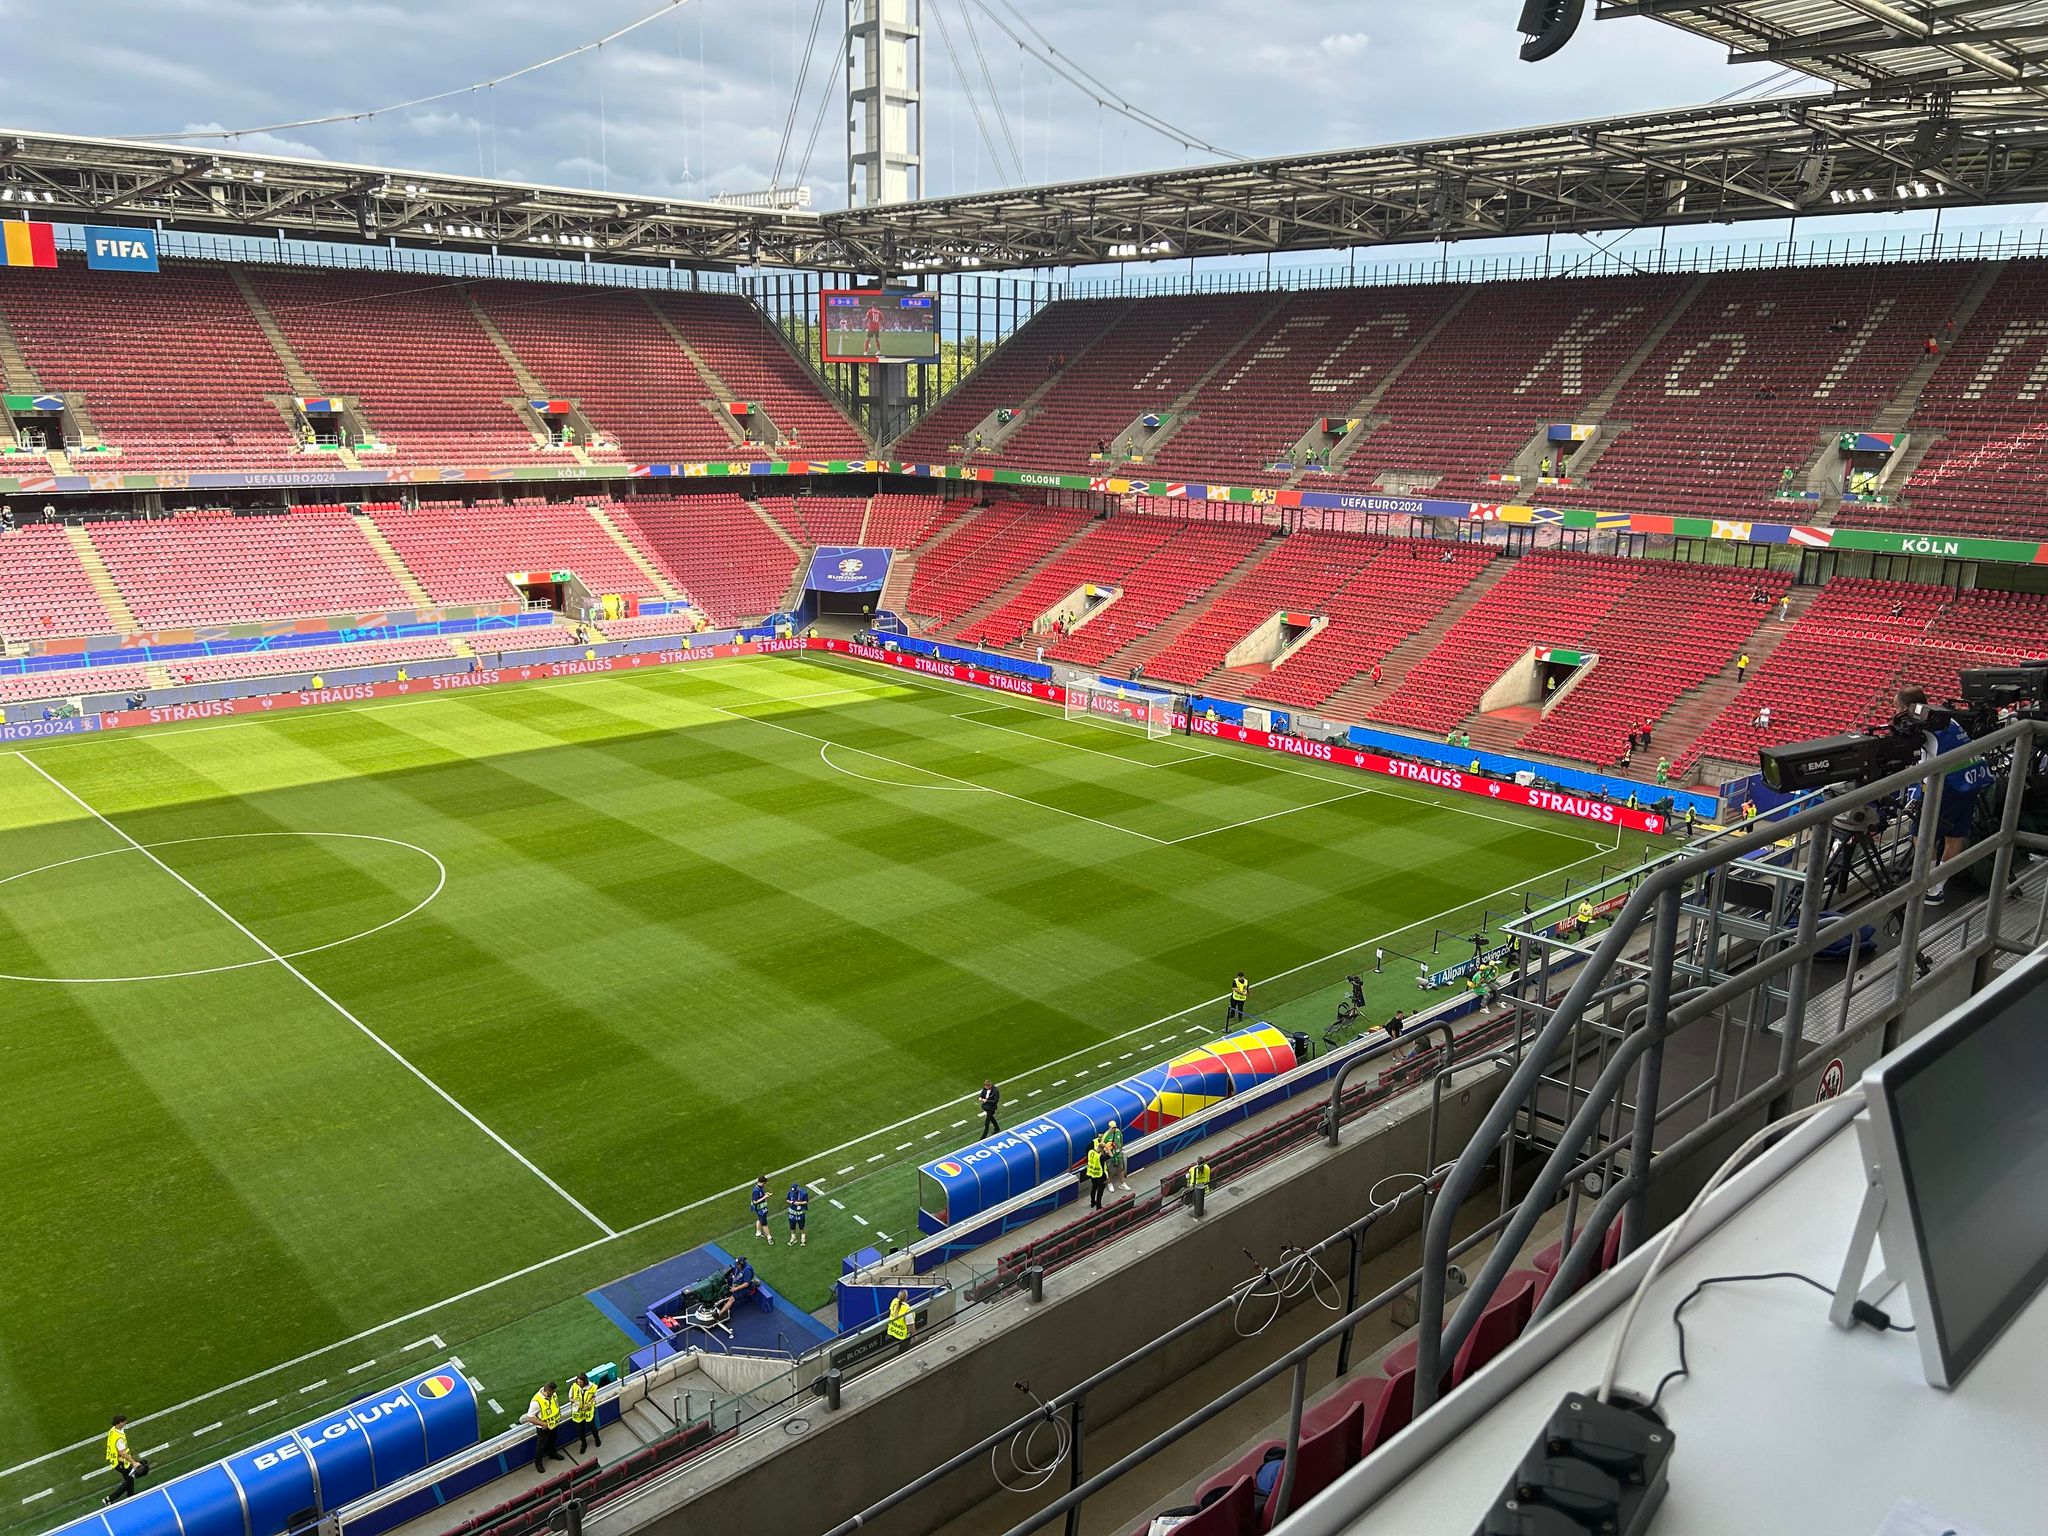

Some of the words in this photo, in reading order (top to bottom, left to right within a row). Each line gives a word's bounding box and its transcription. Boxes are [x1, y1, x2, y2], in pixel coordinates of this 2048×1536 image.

[95, 239, 149, 259] FIFA
[557, 467, 587, 478] KÖLN
[1020, 473, 1061, 486] COLOGNE
[1901, 537, 1959, 555] KÖLN
[757, 639, 807, 653] STRAUSS
[849, 643, 885, 661] STRAUSS
[659, 648, 714, 663] STRAUSS
[552, 659, 612, 676] STRAUSS
[915, 658, 955, 676] STRAUSS
[433, 671, 500, 690] STRAUSS
[989, 674, 1033, 694] STRAUSS
[300, 685, 375, 705] STRAUSS
[150, 701, 234, 723] STRAUSS
[0, 720, 75, 739] RO2024
[1267, 735, 1332, 760] STRAUSS
[1808, 759, 1830, 771] EMG
[1388, 760, 1462, 789] STRAUSS
[1527, 790, 1614, 822] STRAUSS
[1441, 964, 1466, 982] Alipay
[962, 1124, 1055, 1165] ROMANIA
[846, 1344, 869, 1361] BLOCK
[252, 1395, 411, 1471] BELGIUM
